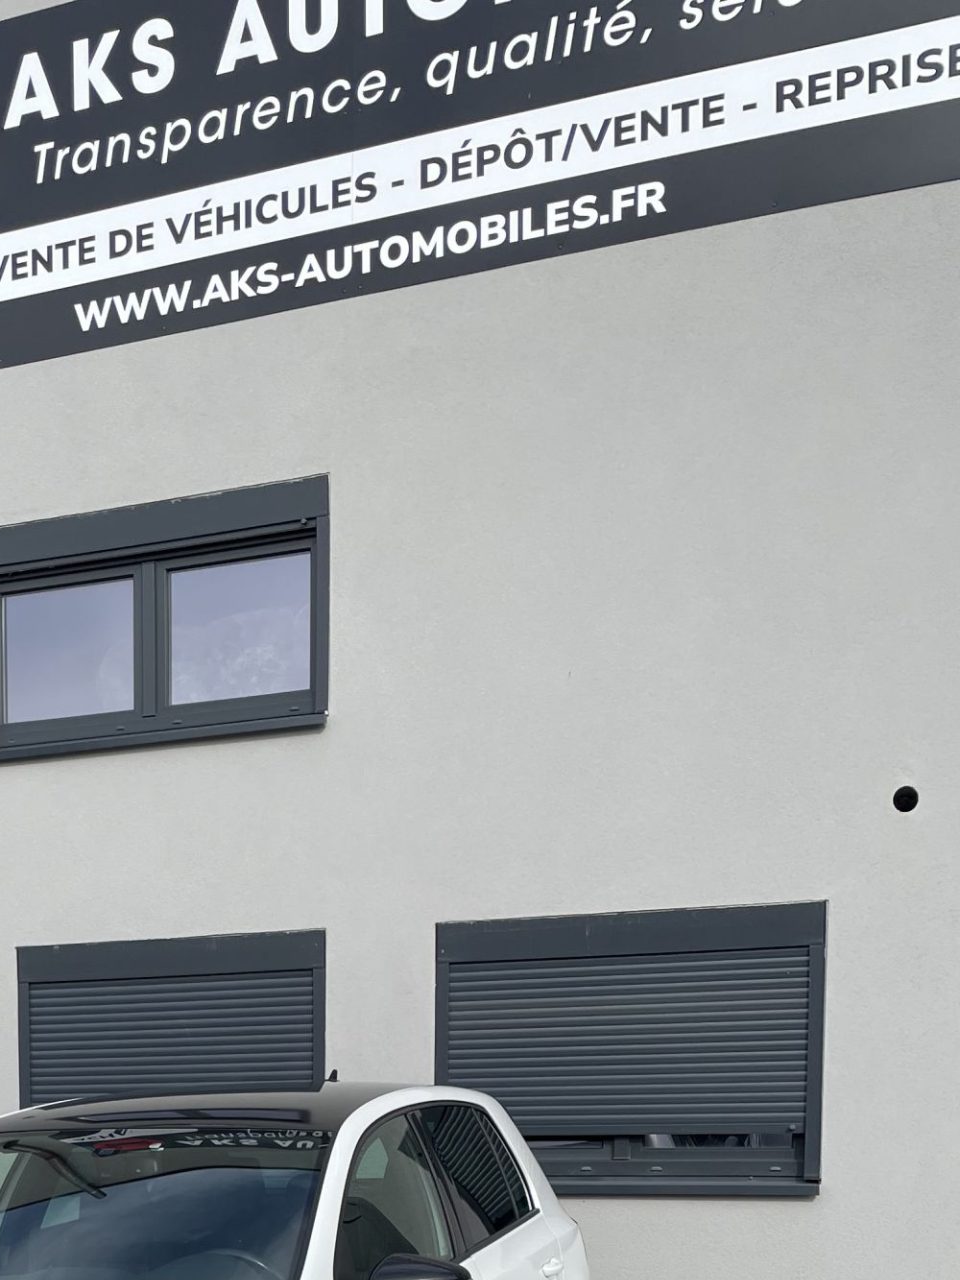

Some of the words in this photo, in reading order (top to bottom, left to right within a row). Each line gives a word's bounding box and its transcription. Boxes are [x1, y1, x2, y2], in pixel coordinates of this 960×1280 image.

[3, 18, 176, 130] AKS
[32, 69, 402, 184] Transparence,
[426, 0, 654, 95] qualité,
[109, 222, 155, 260] DE
[166, 171, 378, 244] VÉHICULES
[419, 93, 726, 190] DÉPÔT/VENTE
[73, 181, 667, 332] WWW.AKS-AUTOMOBILES.FR
